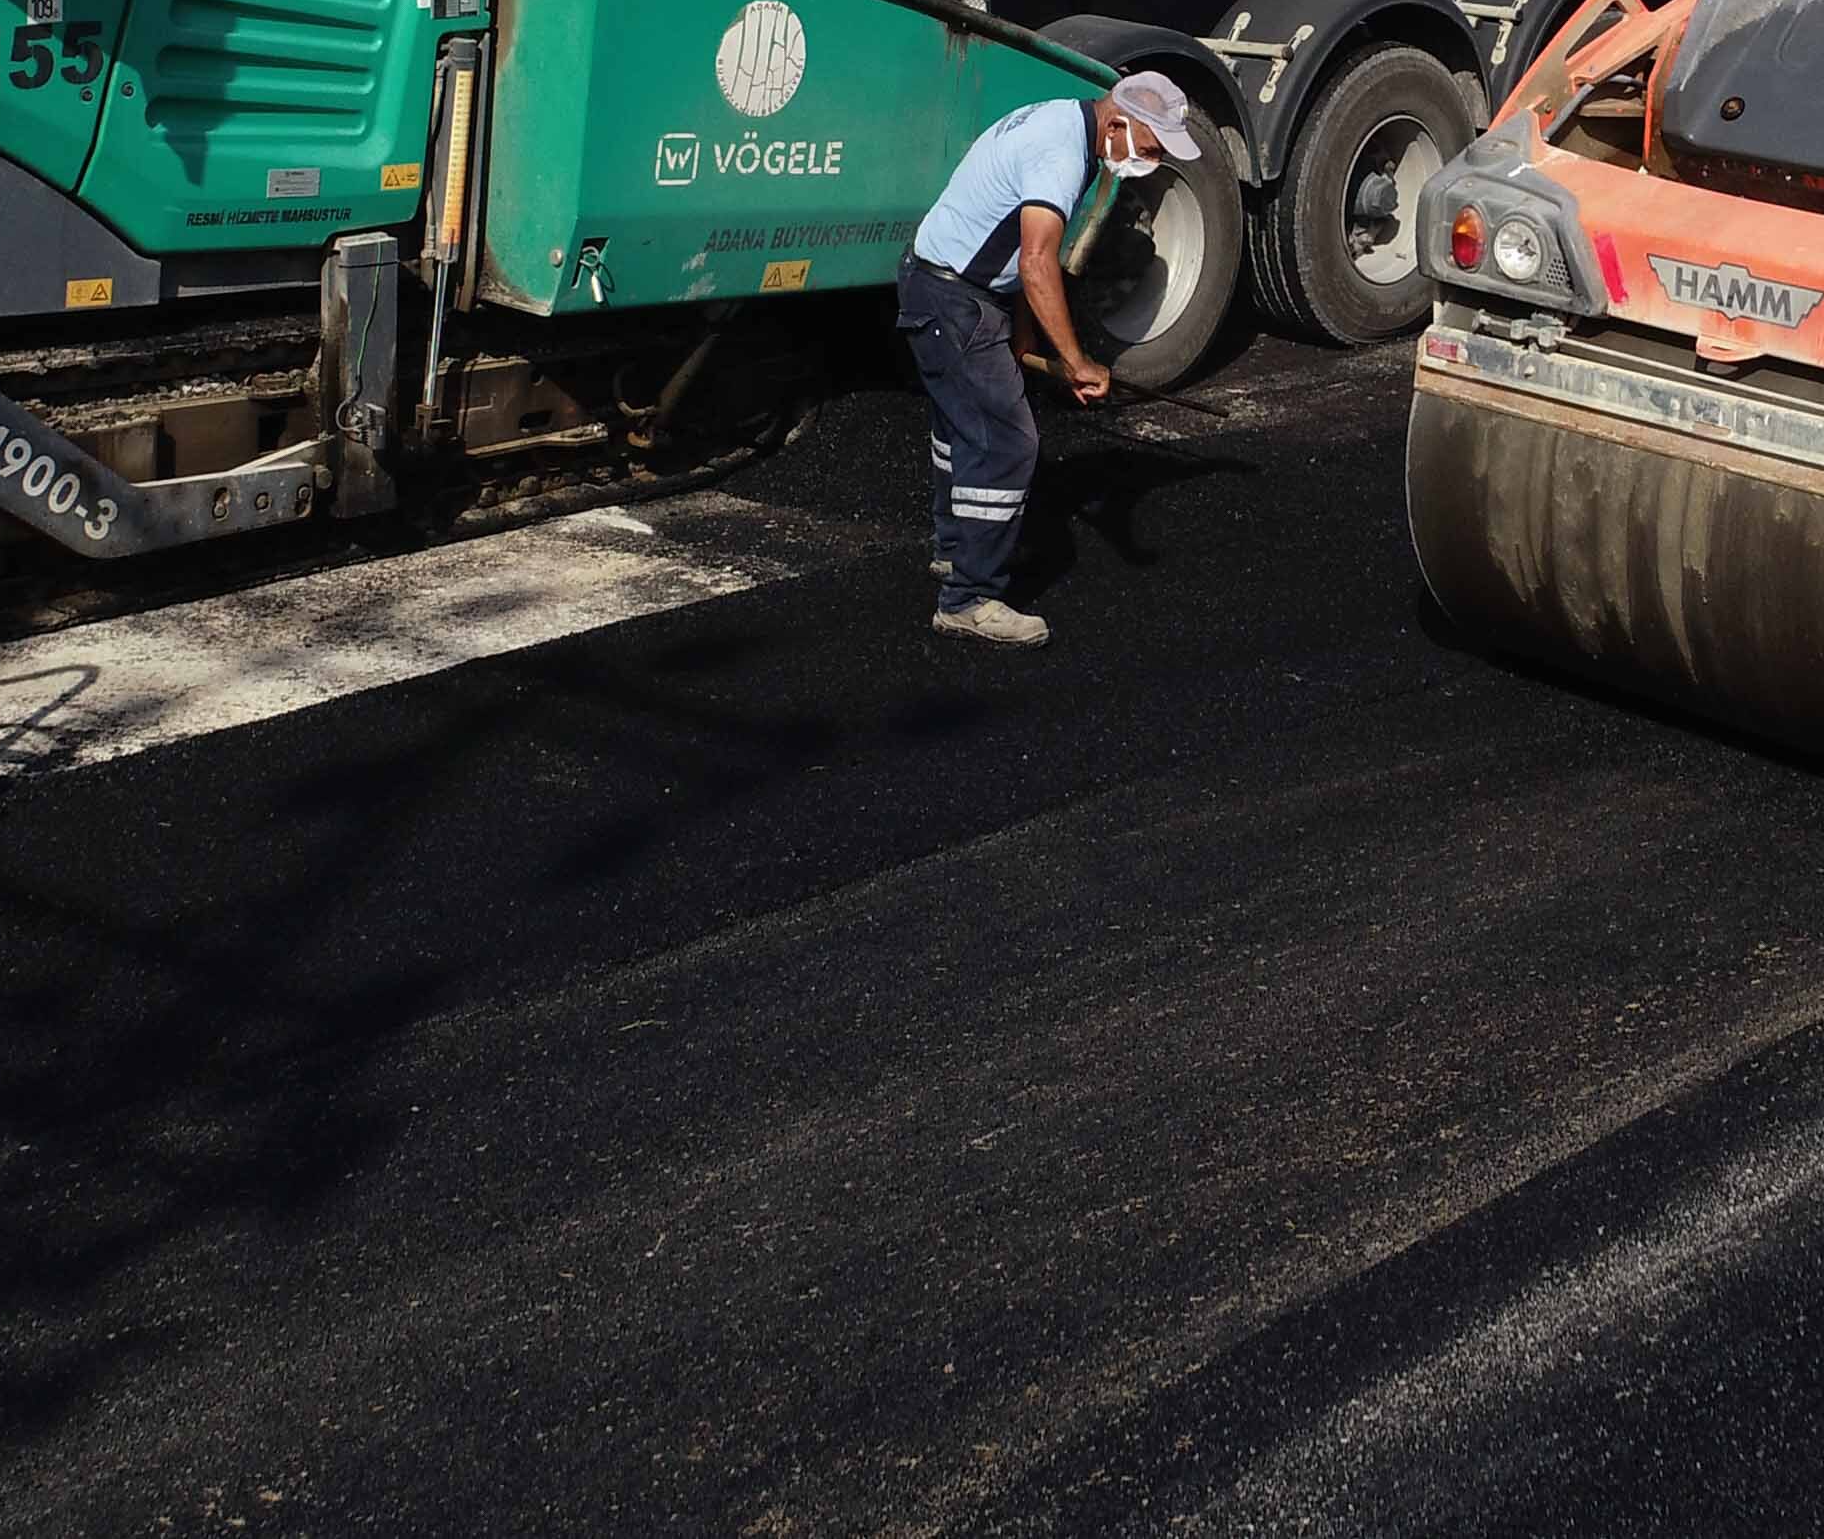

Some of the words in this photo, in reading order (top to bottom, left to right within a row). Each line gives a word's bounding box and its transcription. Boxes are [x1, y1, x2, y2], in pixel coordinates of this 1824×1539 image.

[714, 131, 844, 175] VÖGELE
[281, 207, 352, 223] MAHSUSTUR
[704, 227, 768, 253] ADANA
[770, 217, 889, 250] BÜYÜKŞEHİR
[1676, 267, 1793, 322] HAMM
